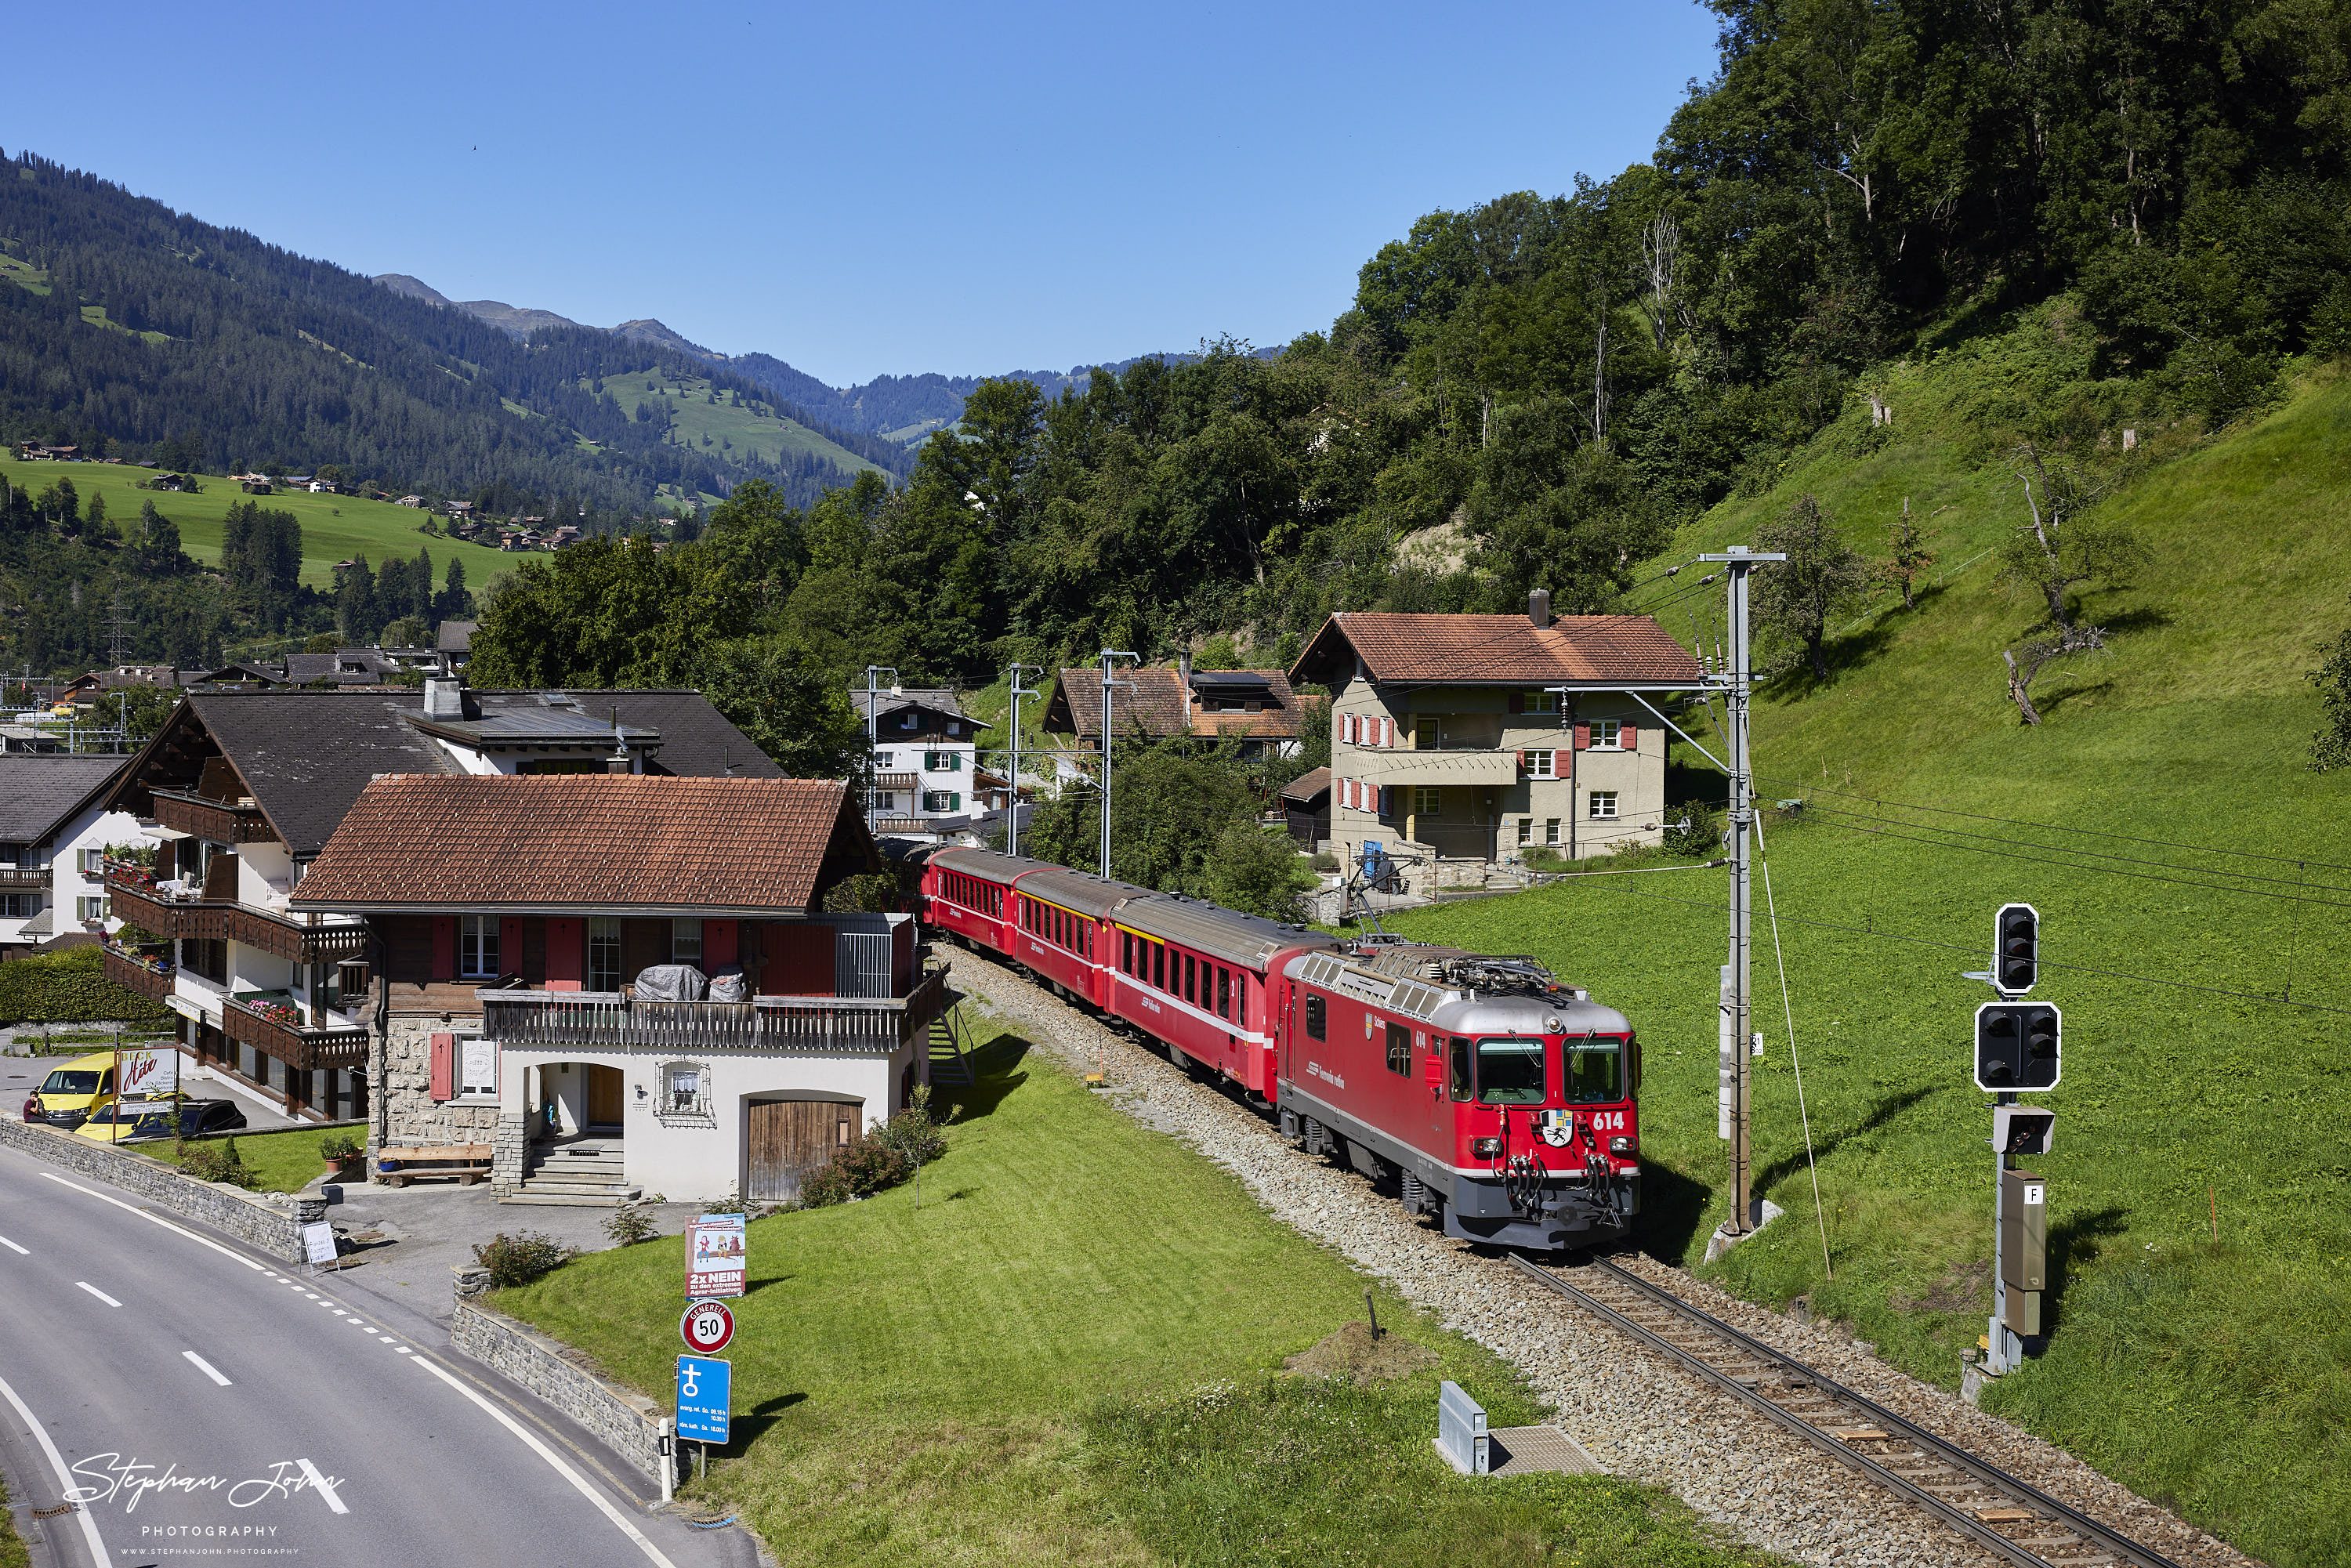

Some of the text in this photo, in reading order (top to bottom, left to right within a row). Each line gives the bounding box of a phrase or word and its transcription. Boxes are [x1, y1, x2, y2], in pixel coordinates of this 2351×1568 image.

[1231, 980, 1235, 998] 2
[1415, 1030, 1426, 1049] 614
[121, 1051, 153, 1061] BECK
[1593, 1112, 1625, 1131] 614
[2031, 1188, 2038, 1202] F
[690, 1271, 741, 1284] 2x NEIN
[690, 1287, 741, 1295] Agrar-Initiativen
[690, 1304, 726, 1320] GENERELL
[699, 1319, 719, 1337] 50
